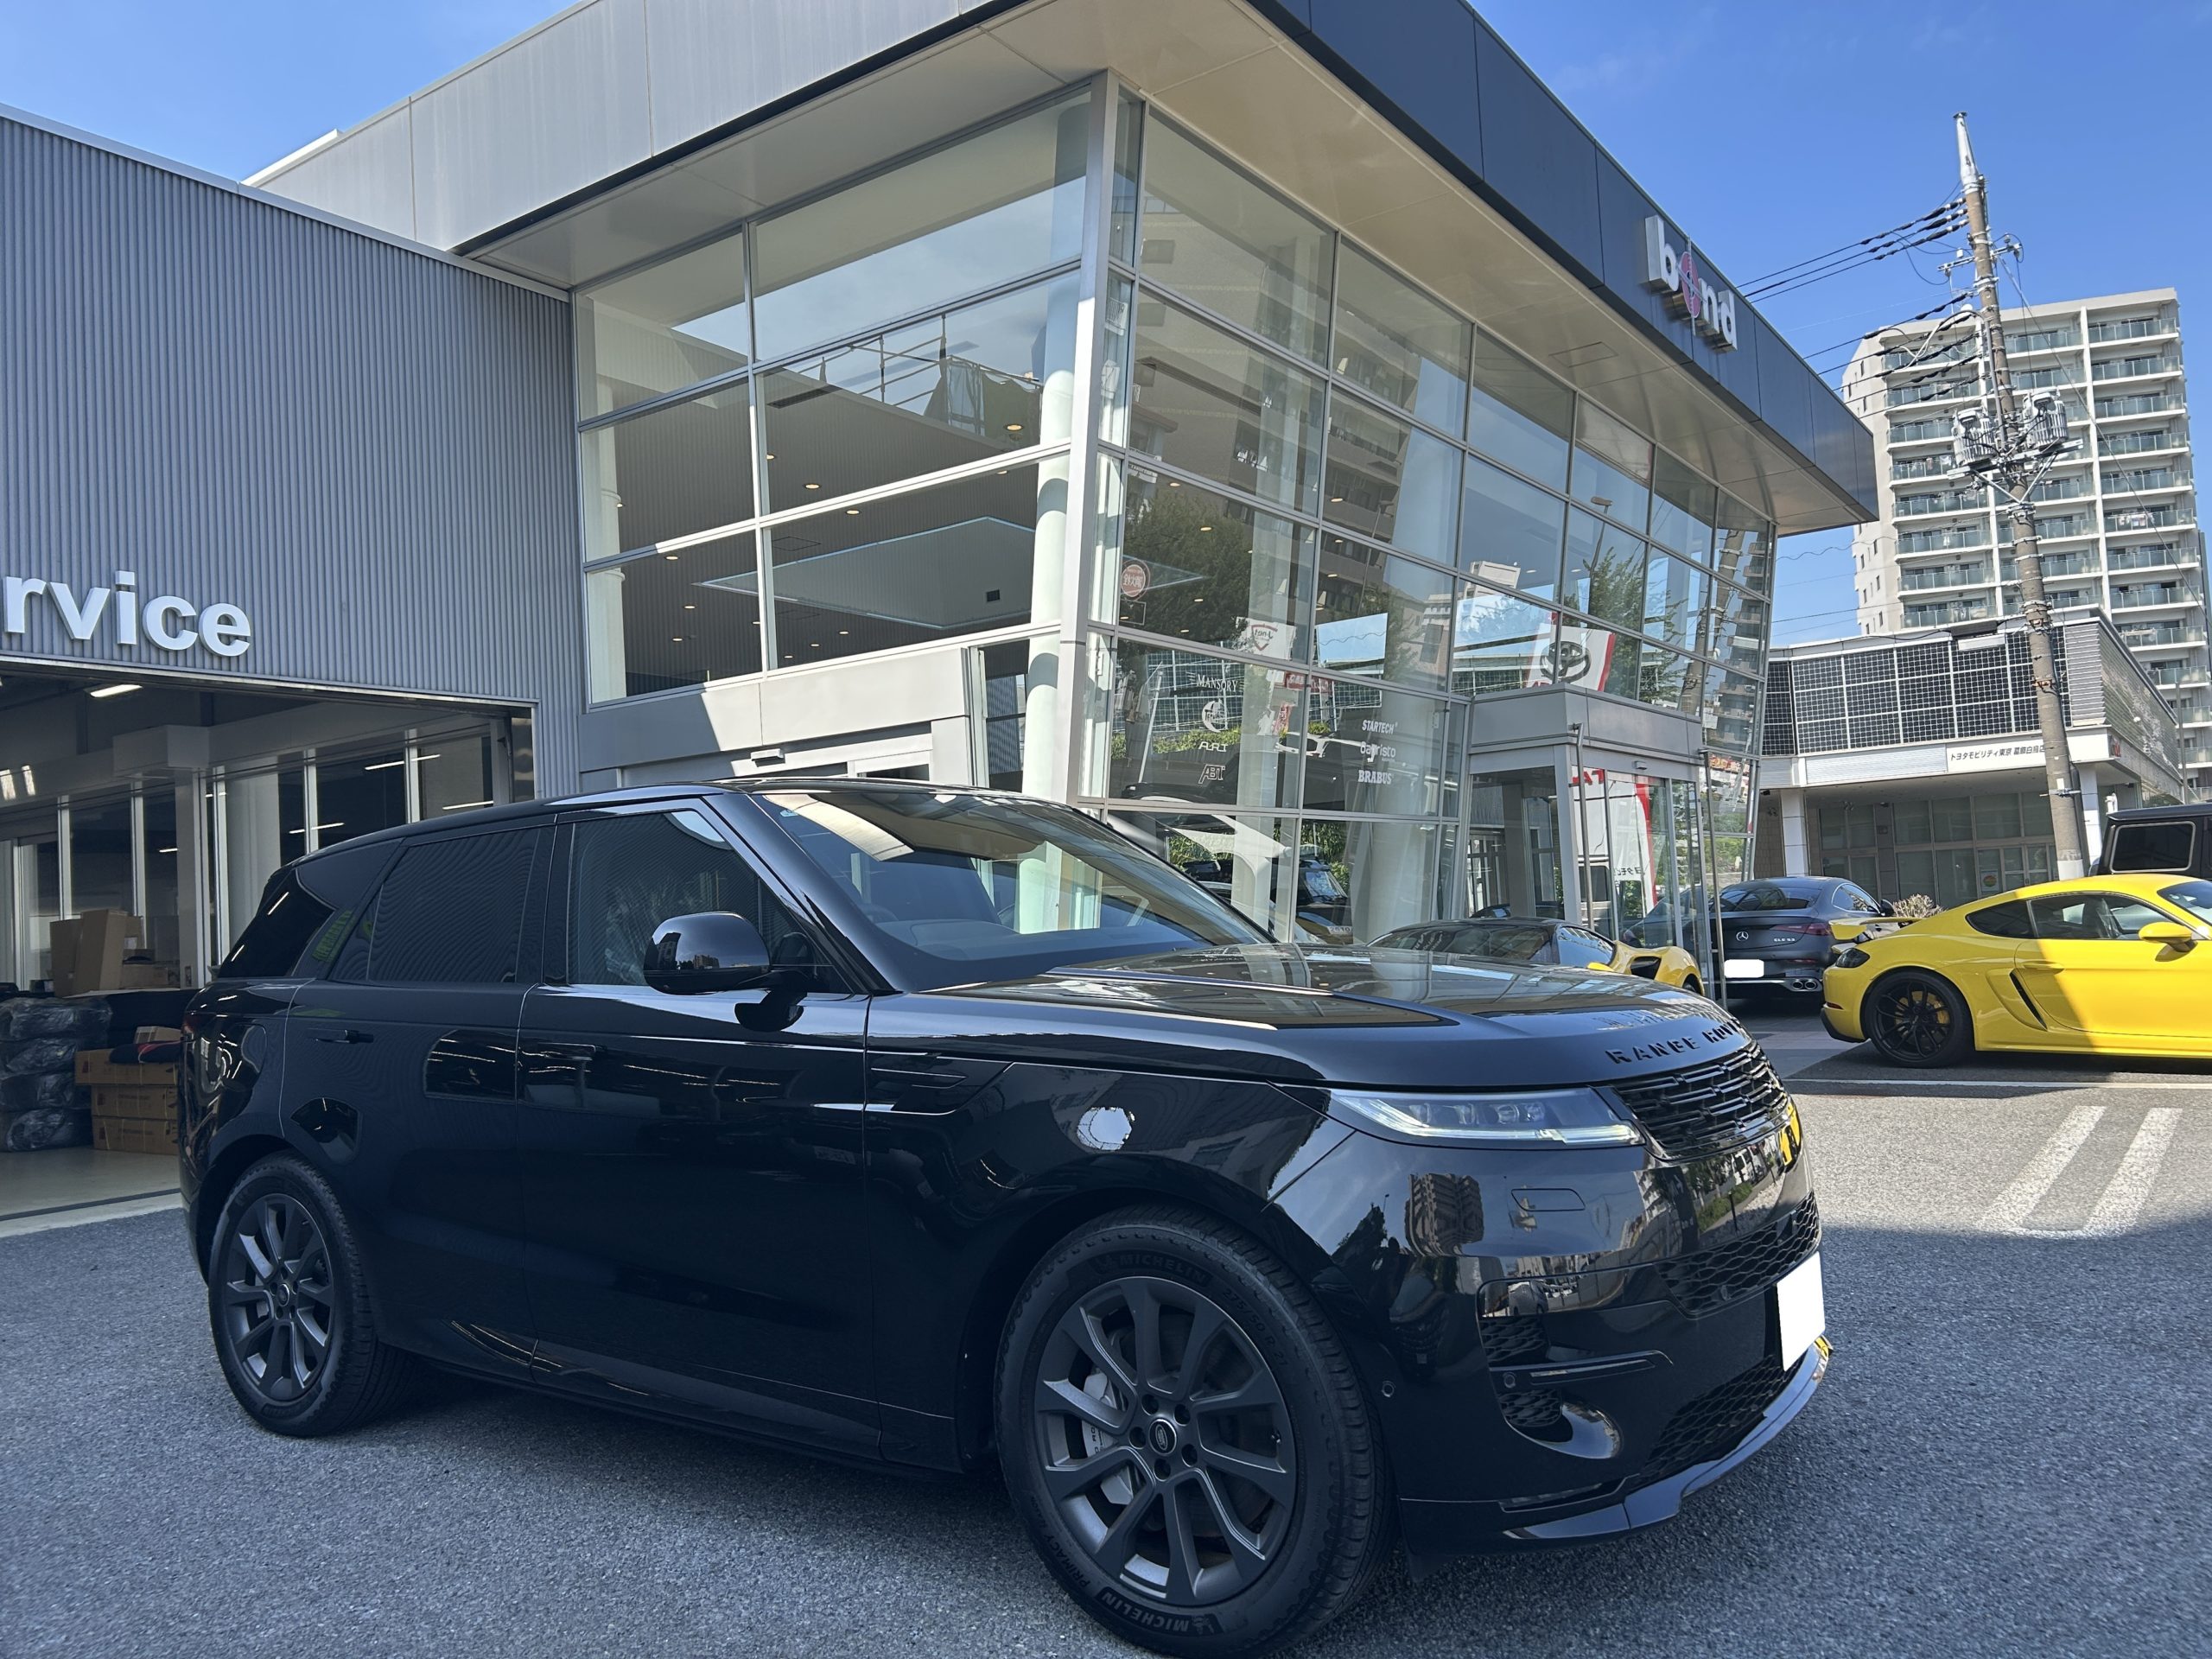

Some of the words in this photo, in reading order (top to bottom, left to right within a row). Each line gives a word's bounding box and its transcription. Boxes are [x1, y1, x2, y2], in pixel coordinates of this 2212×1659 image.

[2, 569, 251, 658] rvice
[1196, 674, 1238, 692] MANSORY
[1362, 720, 1395, 734] STARTECH
[1950, 747, 2012, 761] トヨタモビリティ東京
[1358, 769, 1392, 785] BRABUS
[1605, 1037, 1700, 1064] RANGE
[1119, 1254, 1208, 1283] MICHELIN
[1043, 1535, 1089, 1588] PRIMACY
[1102, 1592, 1190, 1632] MICHELIN
